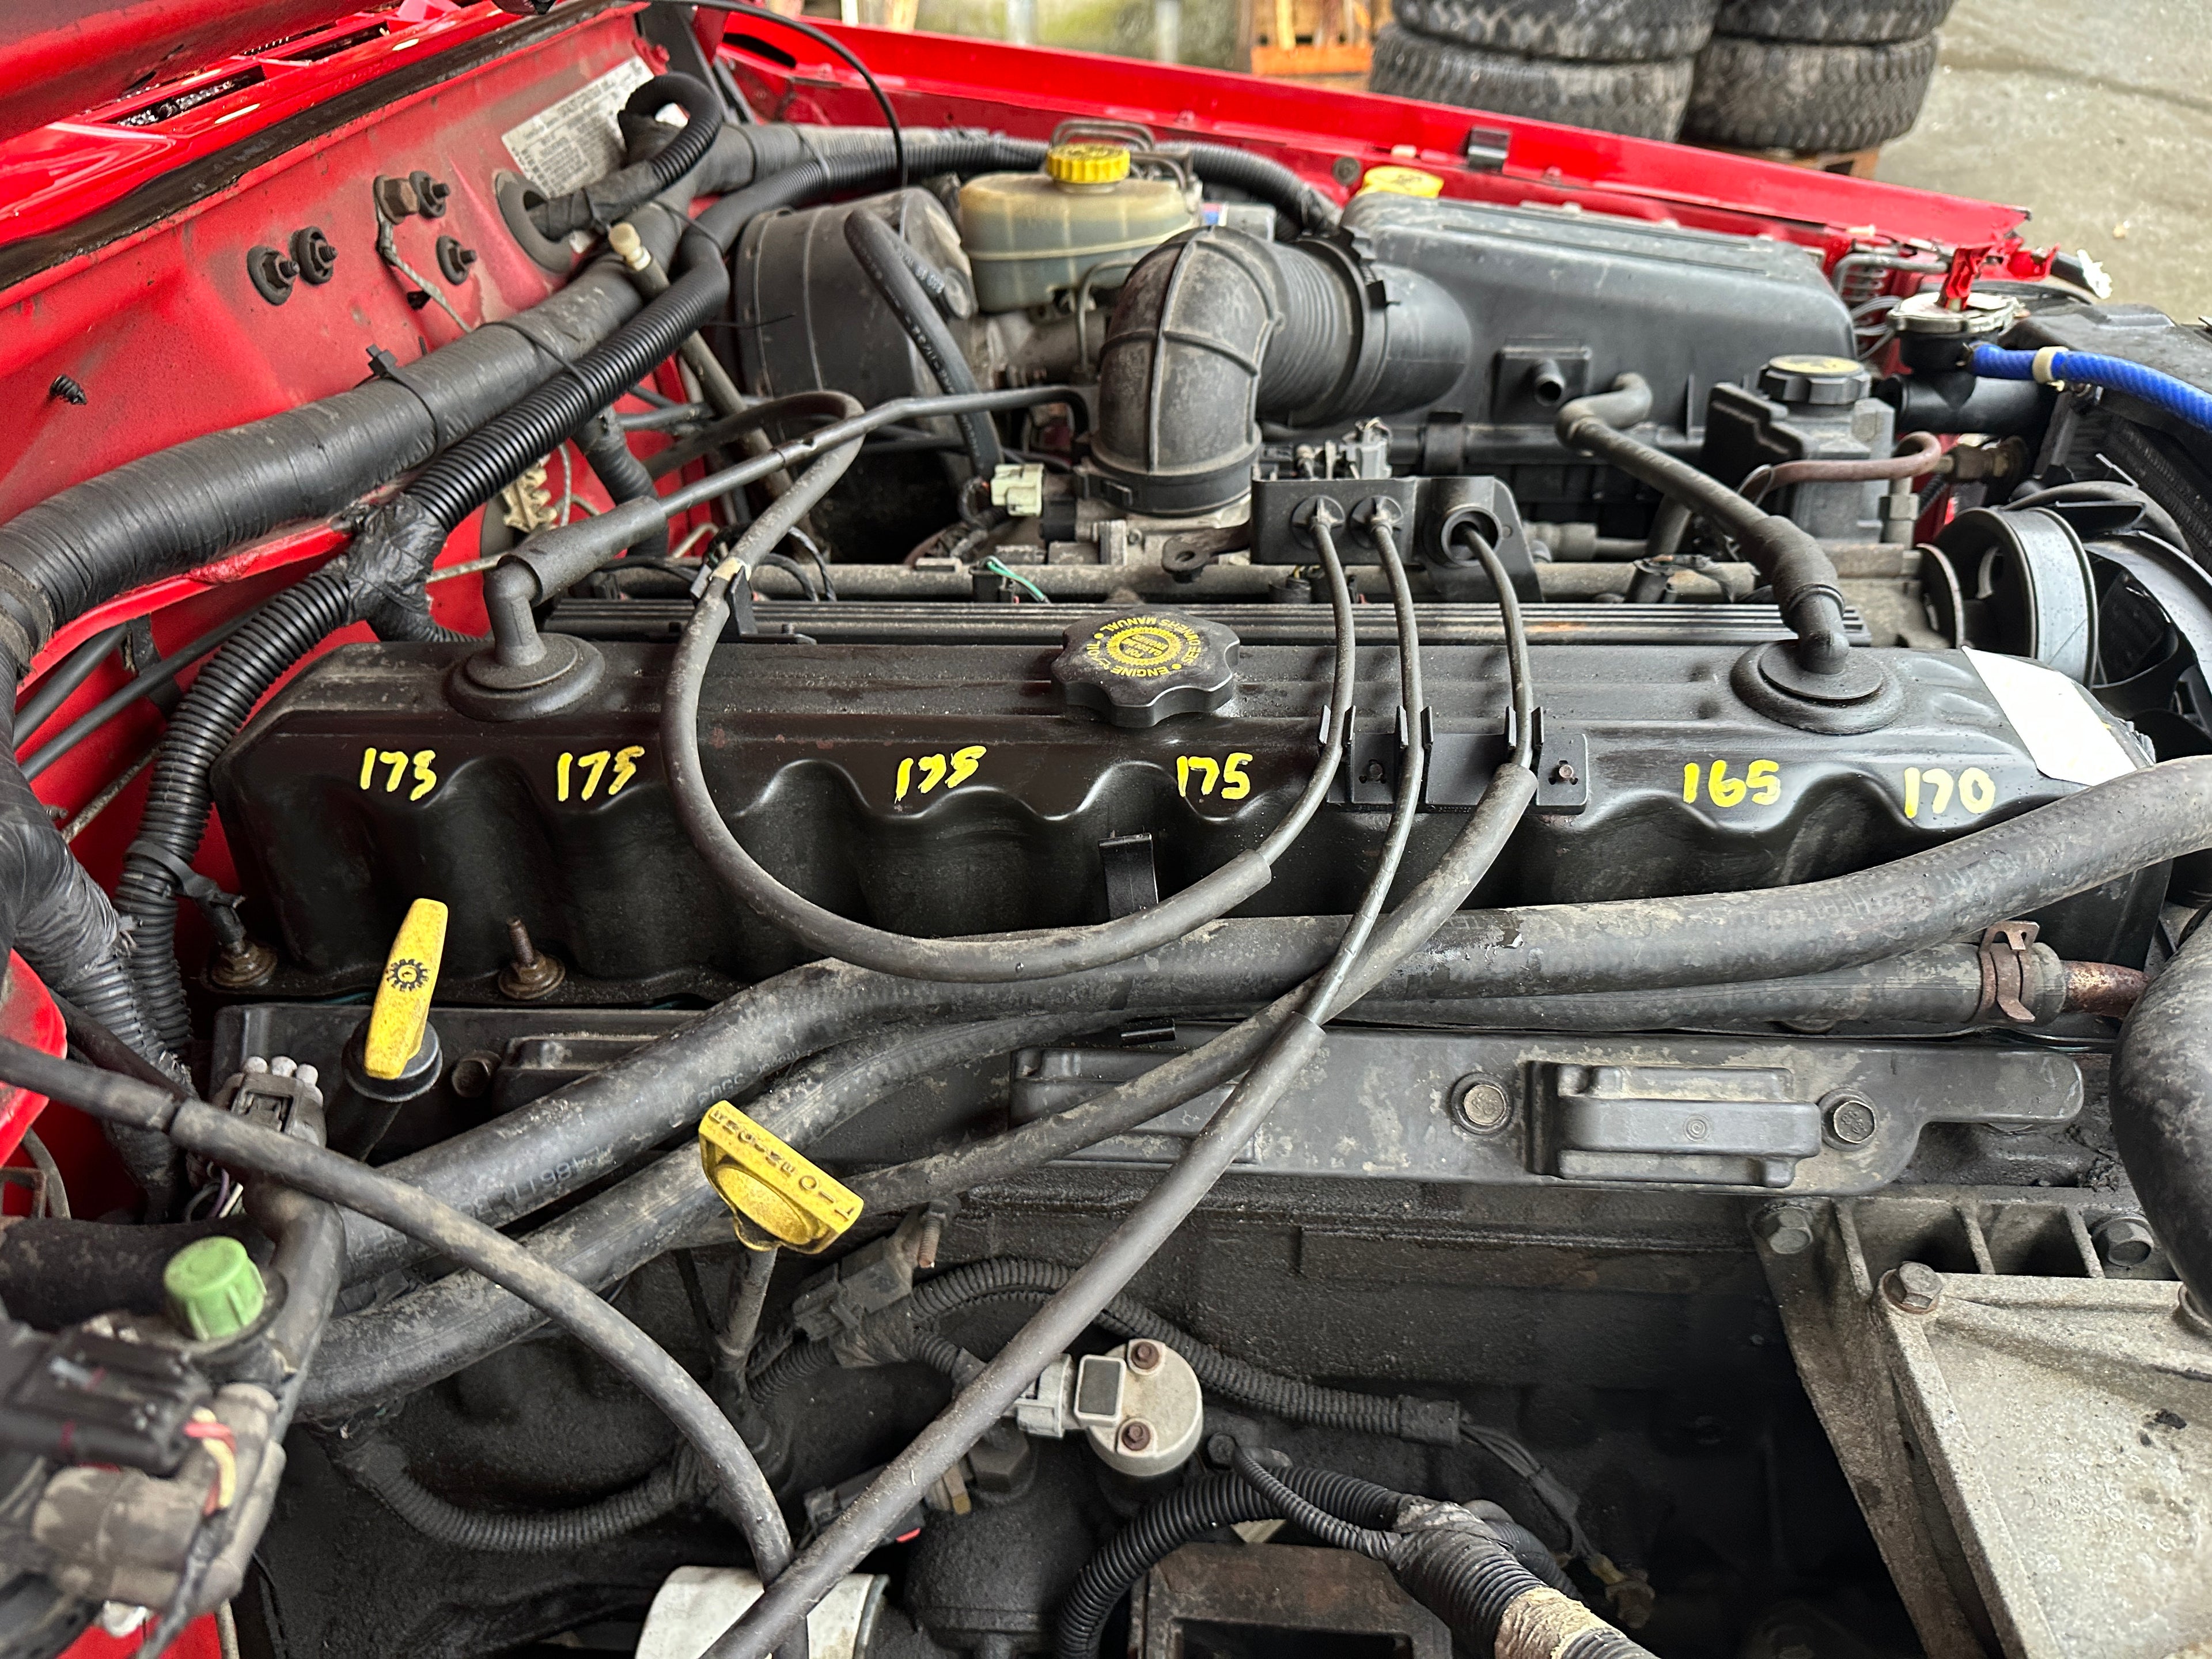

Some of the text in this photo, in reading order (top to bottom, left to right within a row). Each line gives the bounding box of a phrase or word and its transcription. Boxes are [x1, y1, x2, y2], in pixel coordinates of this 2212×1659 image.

[1086, 641, 1170, 677] ENGINE OIL
[1099, 617, 1202, 664] SEE OWNERS MANUAL
[1121, 638, 1163, 656] GASOLINE
[1124, 647, 1145, 658] FOR
[1131, 634, 1169, 650] ENGINES
[359, 747, 437, 801] 175
[557, 745, 645, 802] 175
[895, 745, 987, 804] 175
[1176, 751, 1253, 800] 175
[1683, 759, 1782, 808] 165
[1904, 767, 1997, 820] 170
[709, 1109, 855, 1222] ENGINE OIL
